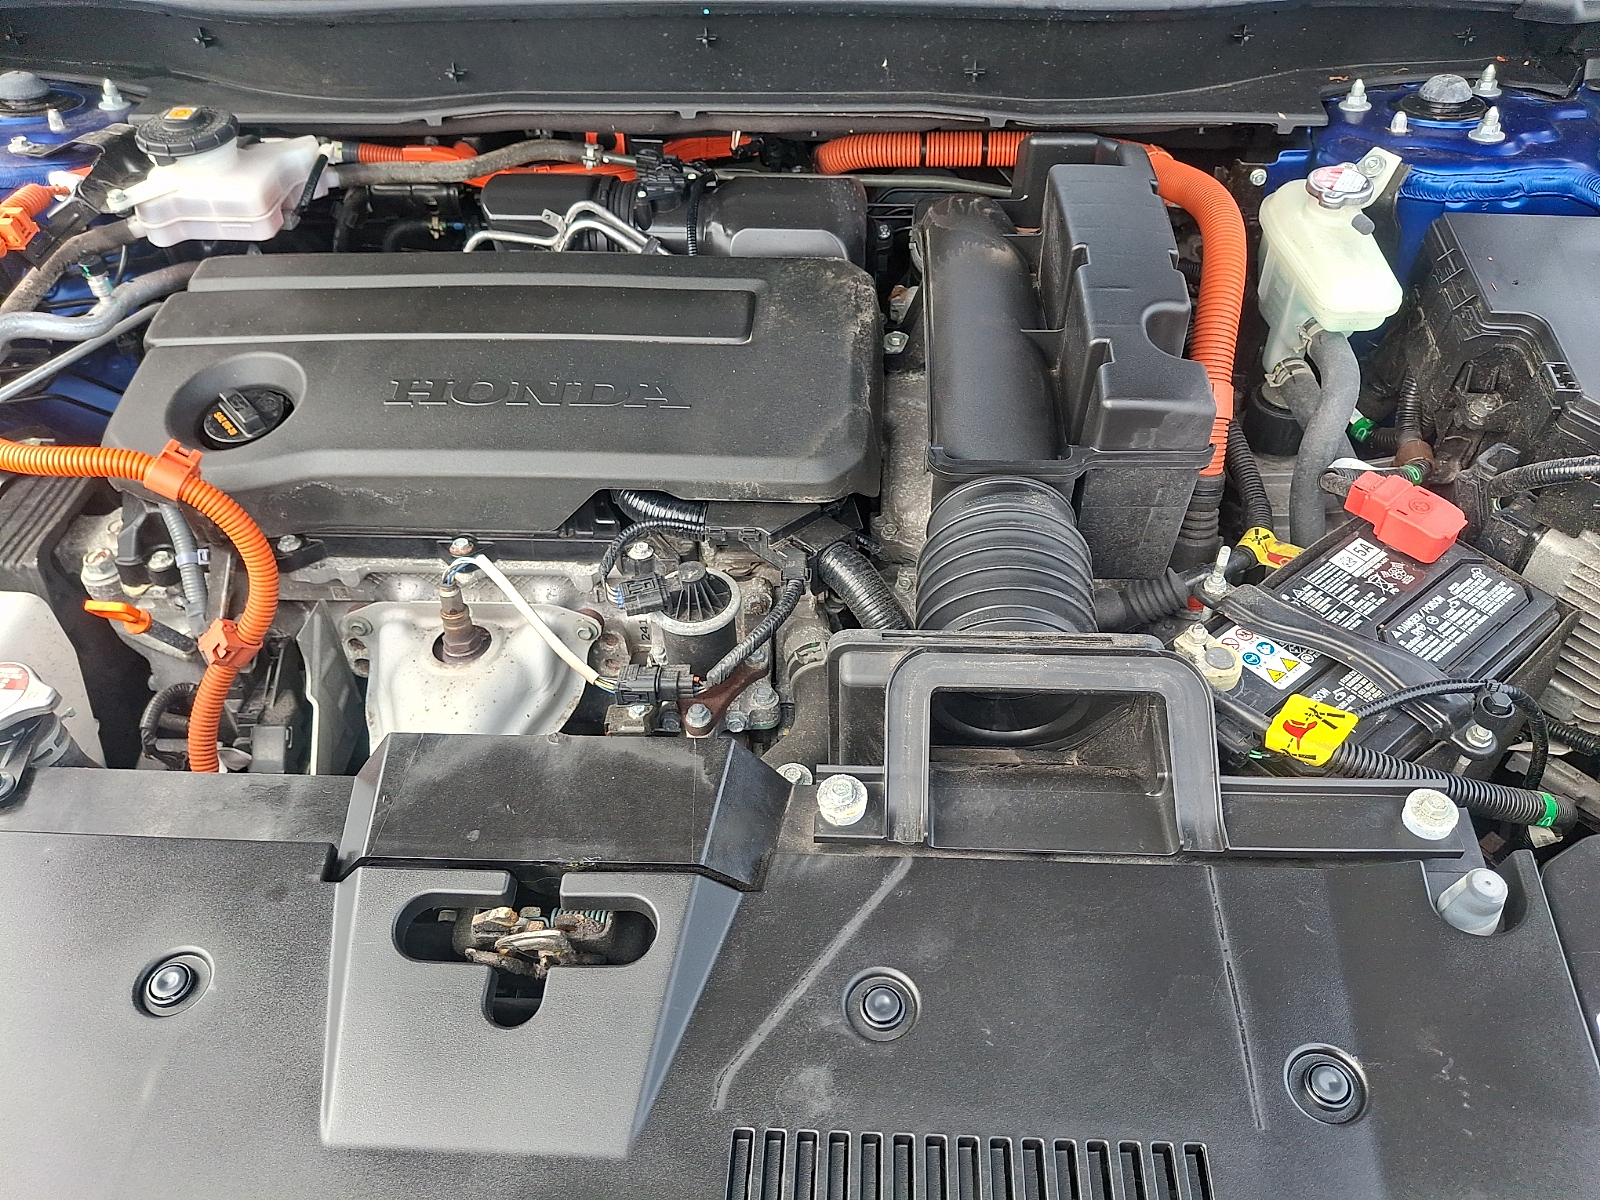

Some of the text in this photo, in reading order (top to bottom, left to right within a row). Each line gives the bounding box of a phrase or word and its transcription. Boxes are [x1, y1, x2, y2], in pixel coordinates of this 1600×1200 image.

[382, 378, 691, 409] HONDA
[1353, 543, 1375, 557] 5A
[638, 618, 650, 641] 241
